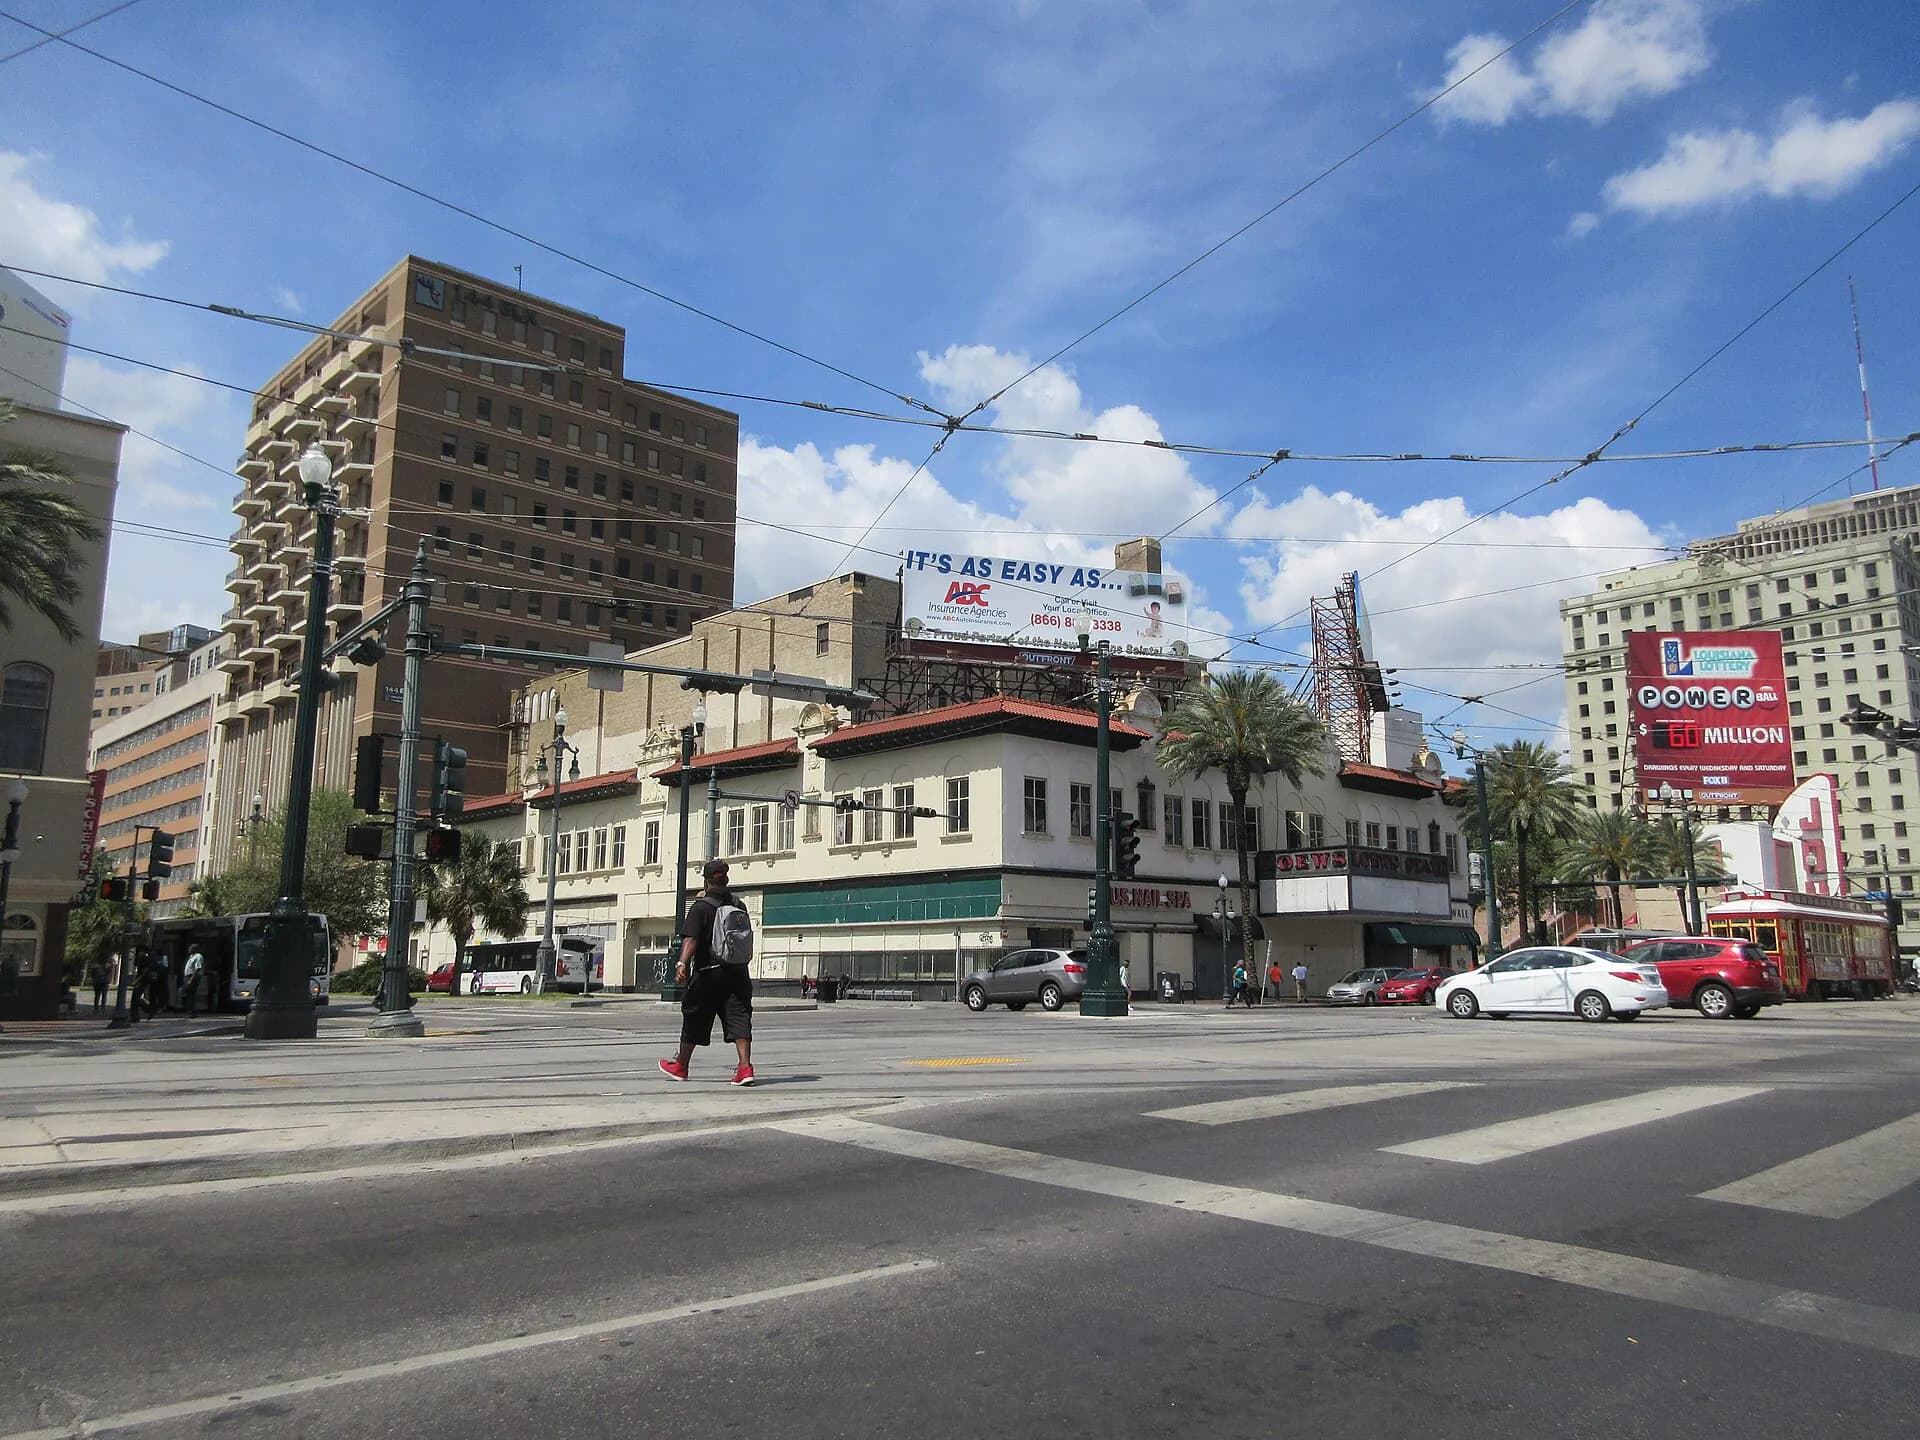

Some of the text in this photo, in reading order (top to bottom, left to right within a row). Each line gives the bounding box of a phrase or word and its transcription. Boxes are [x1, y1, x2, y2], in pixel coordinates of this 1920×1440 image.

[906, 550, 1122, 590] IT'S AS EASY AS...
[944, 581, 991, 607] ABC
[928, 601, 1008, 619] Insurance Agencies
[1063, 605, 1081, 614] Loca
[1031, 613, 1122, 632] (866) 83338
[1022, 652, 1072, 665] OUTFRONT
[1694, 650, 1752, 659] LOUISIANA
[1700, 660, 1750, 671] LOTTERY
[1642, 689, 1778, 706] POWER BALL
[1639, 723, 1784, 748] $ 60 MILLION
[1270, 852, 1347, 872] OEWS
[1167, 890, 1191, 908] SPA
